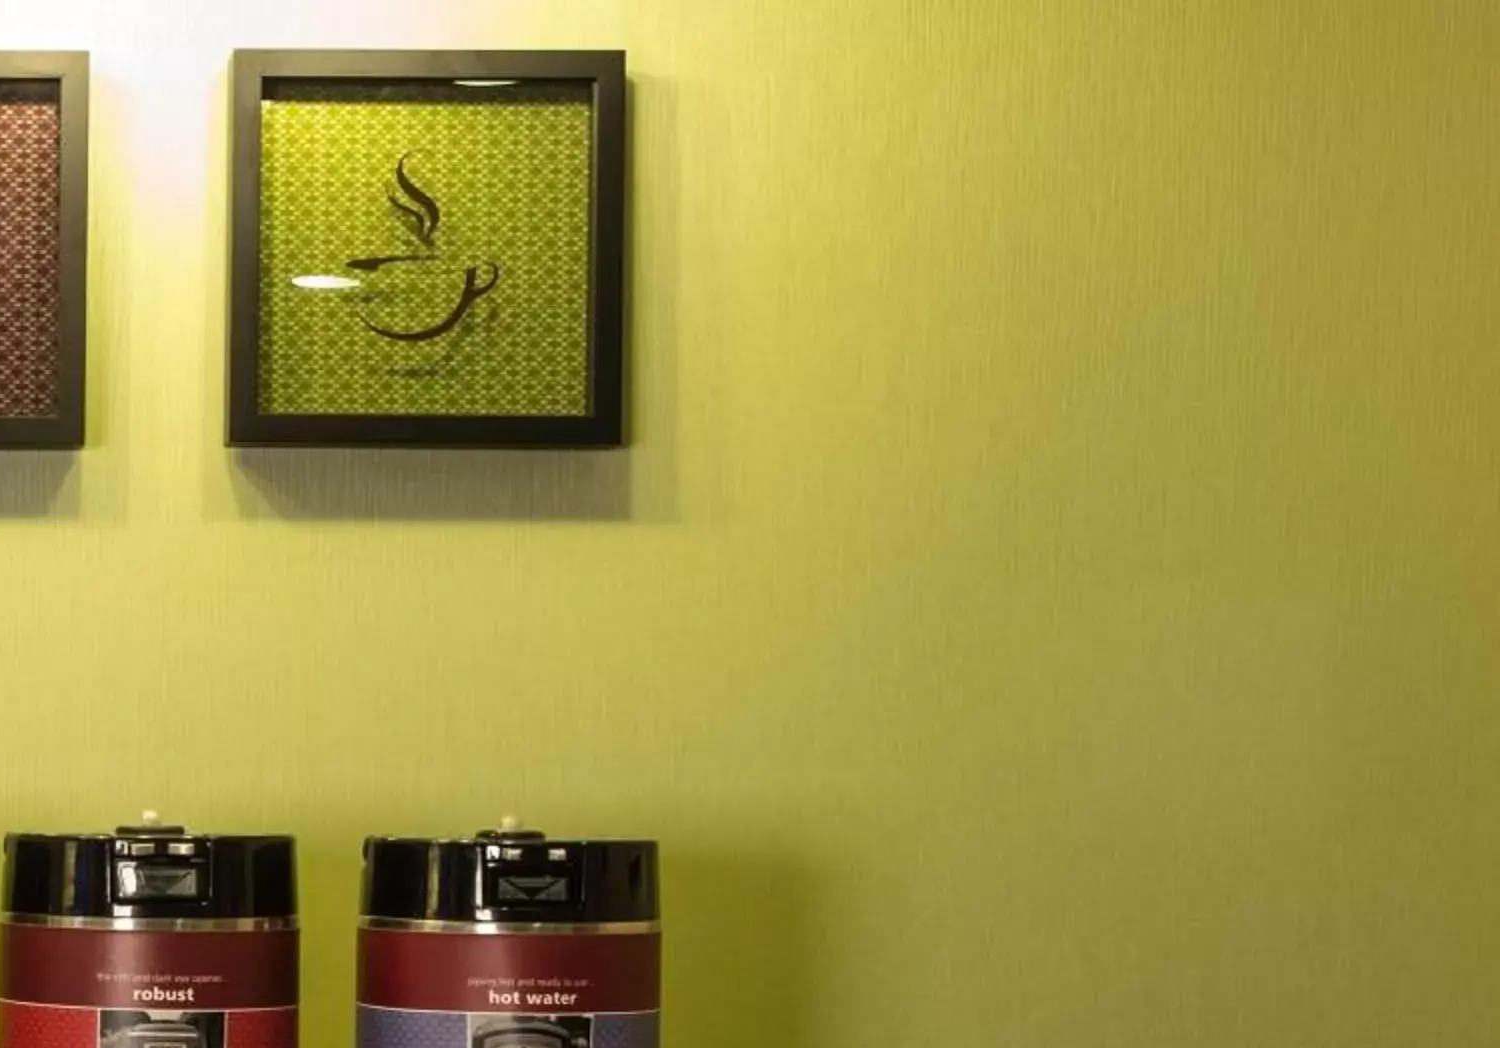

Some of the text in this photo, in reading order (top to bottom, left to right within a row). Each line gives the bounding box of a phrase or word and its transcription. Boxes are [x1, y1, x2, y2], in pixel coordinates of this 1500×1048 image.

[133, 986, 195, 1001] robust
[488, 990, 578, 1005] hot water
